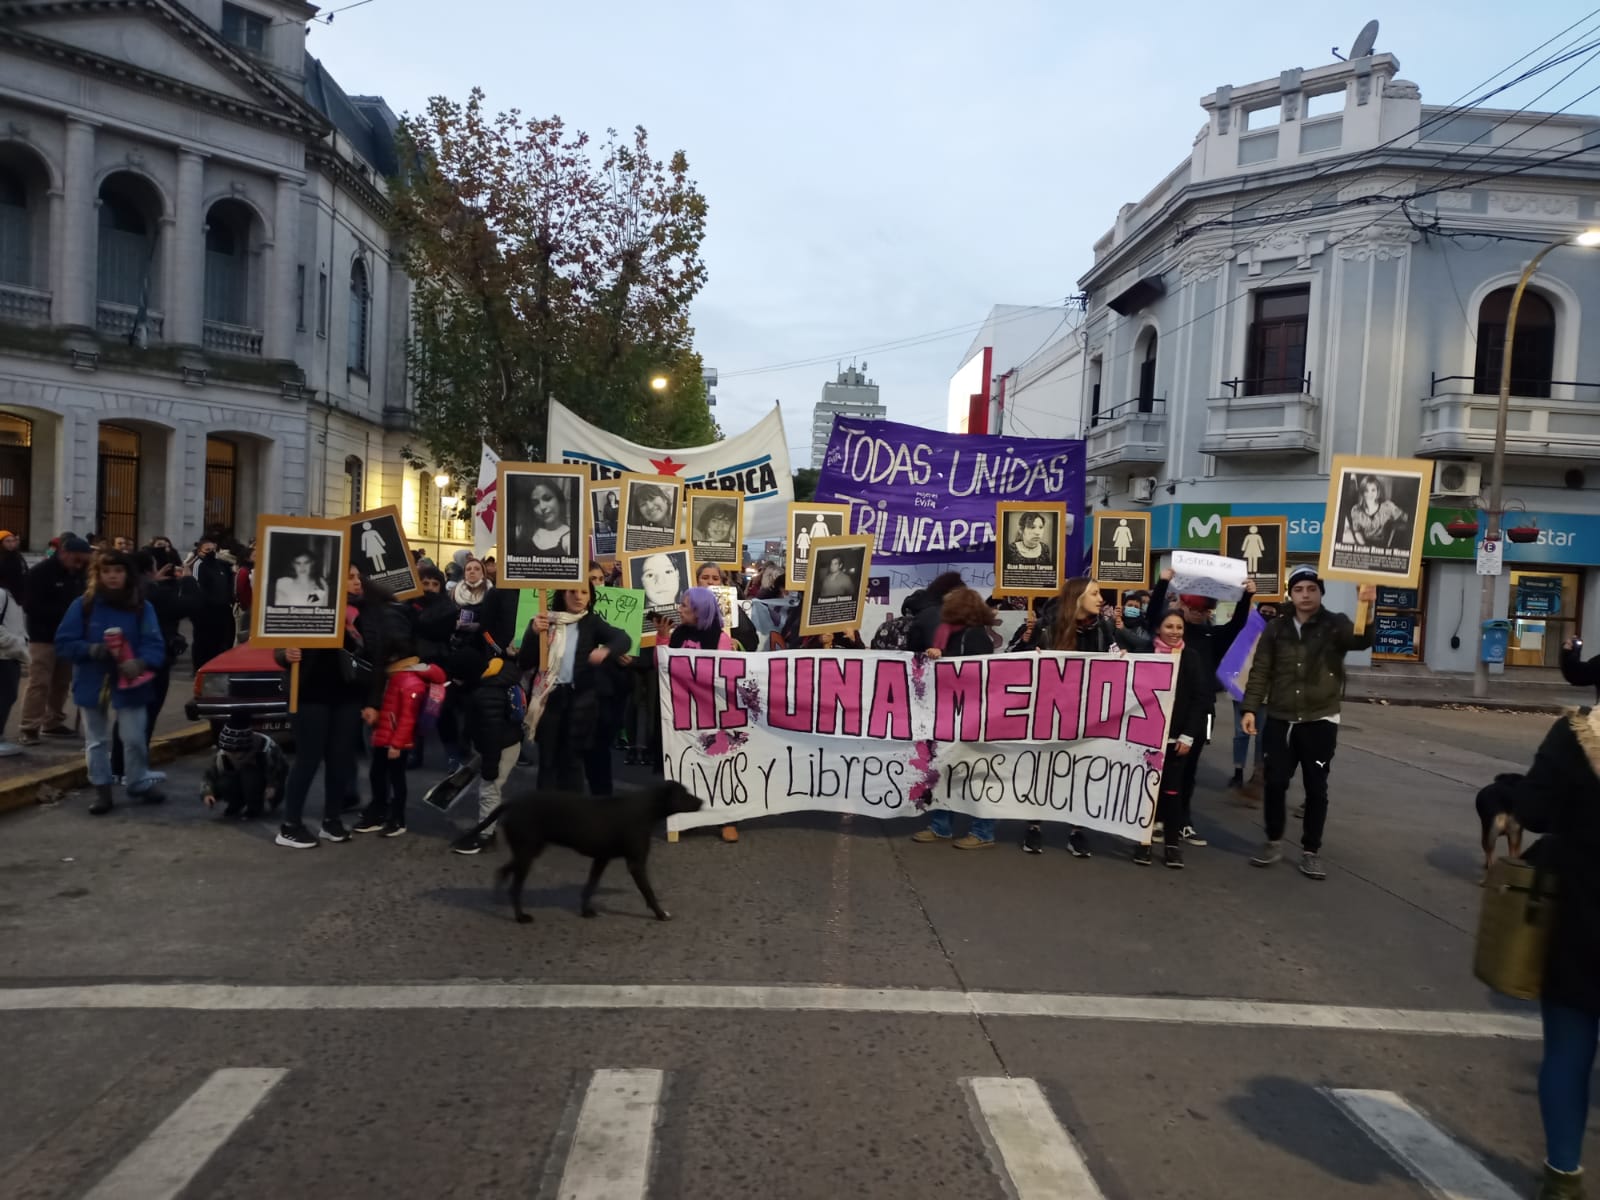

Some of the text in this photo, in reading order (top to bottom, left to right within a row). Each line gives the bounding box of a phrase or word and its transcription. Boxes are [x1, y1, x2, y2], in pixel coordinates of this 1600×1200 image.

[839, 425, 933, 486] TODAS
[668, 655, 1174, 749] NI UNA MENOS
[786, 745, 904, 808] Libres
[946, 753, 1006, 803] nos
